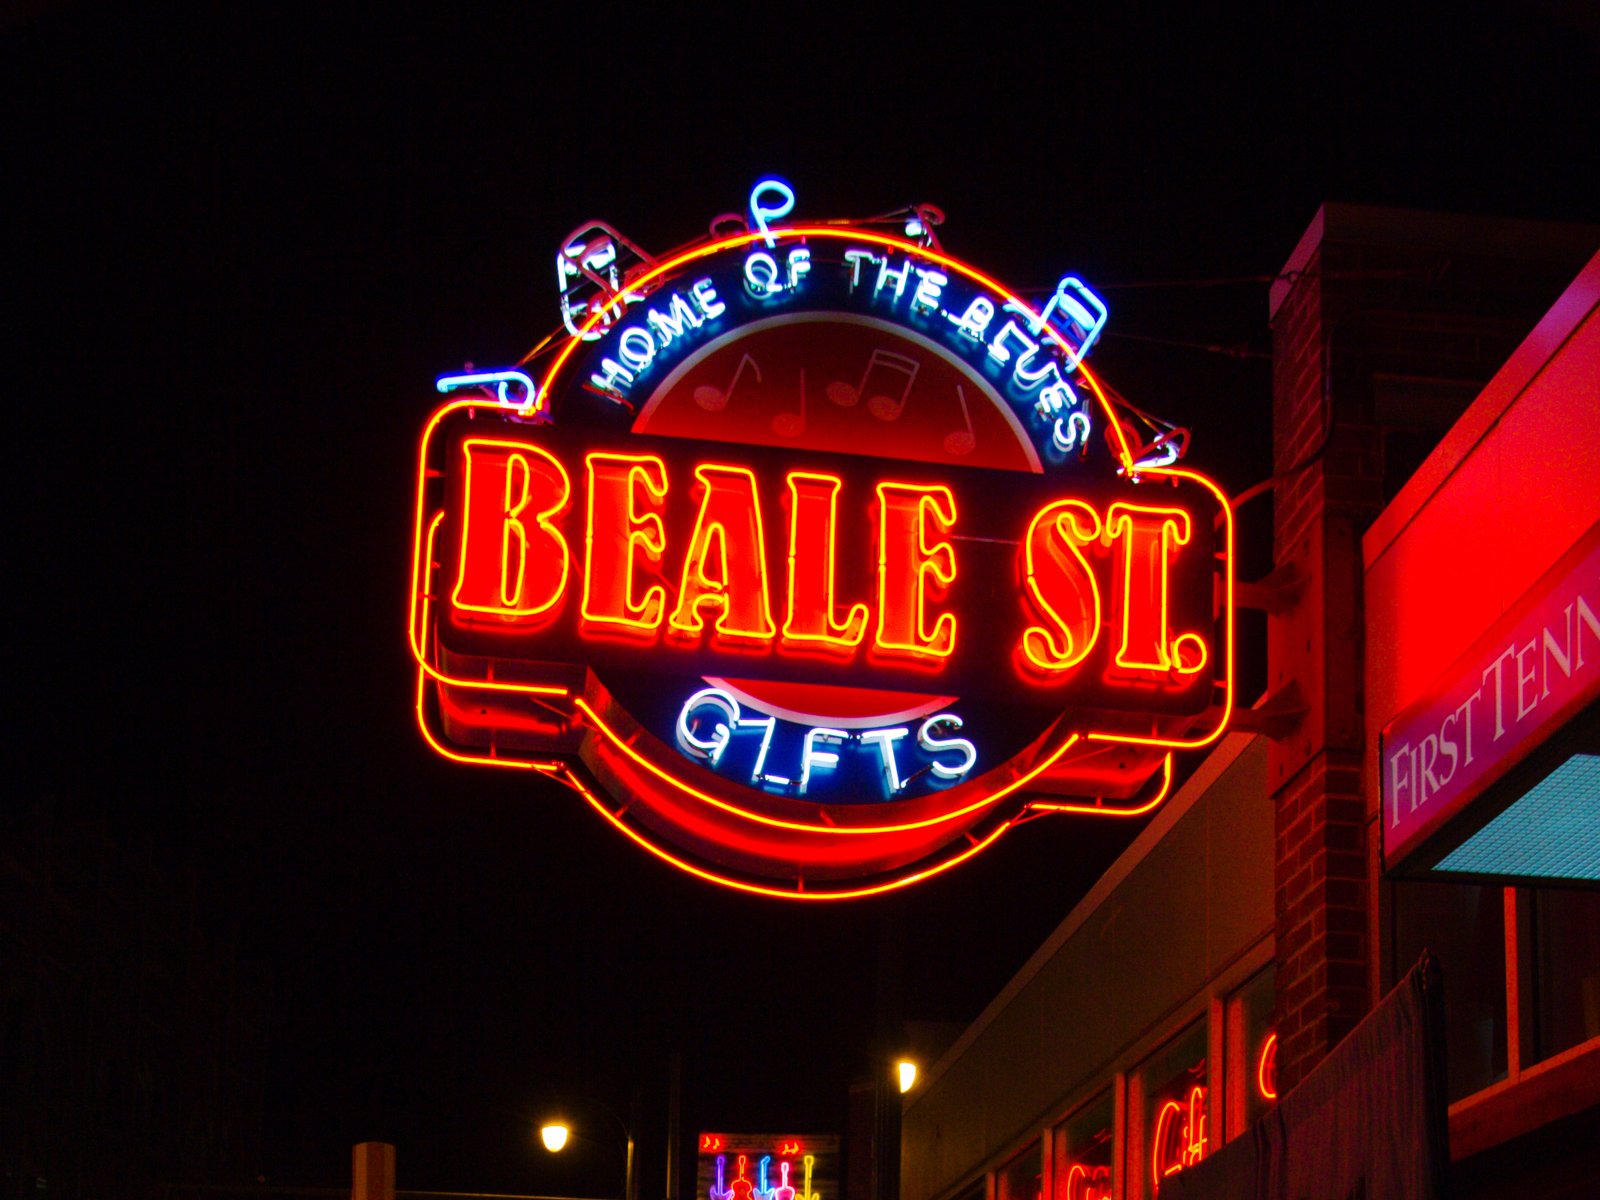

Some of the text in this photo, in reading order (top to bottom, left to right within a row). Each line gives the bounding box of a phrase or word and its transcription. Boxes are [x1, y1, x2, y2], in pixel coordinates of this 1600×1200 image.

[590, 249, 1091, 453] HOME OF THE BLUES
[452, 438, 1208, 680] BEALE ST.
[675, 686, 977, 794] GIFTS
[1389, 686, 1481, 830] FIRST
